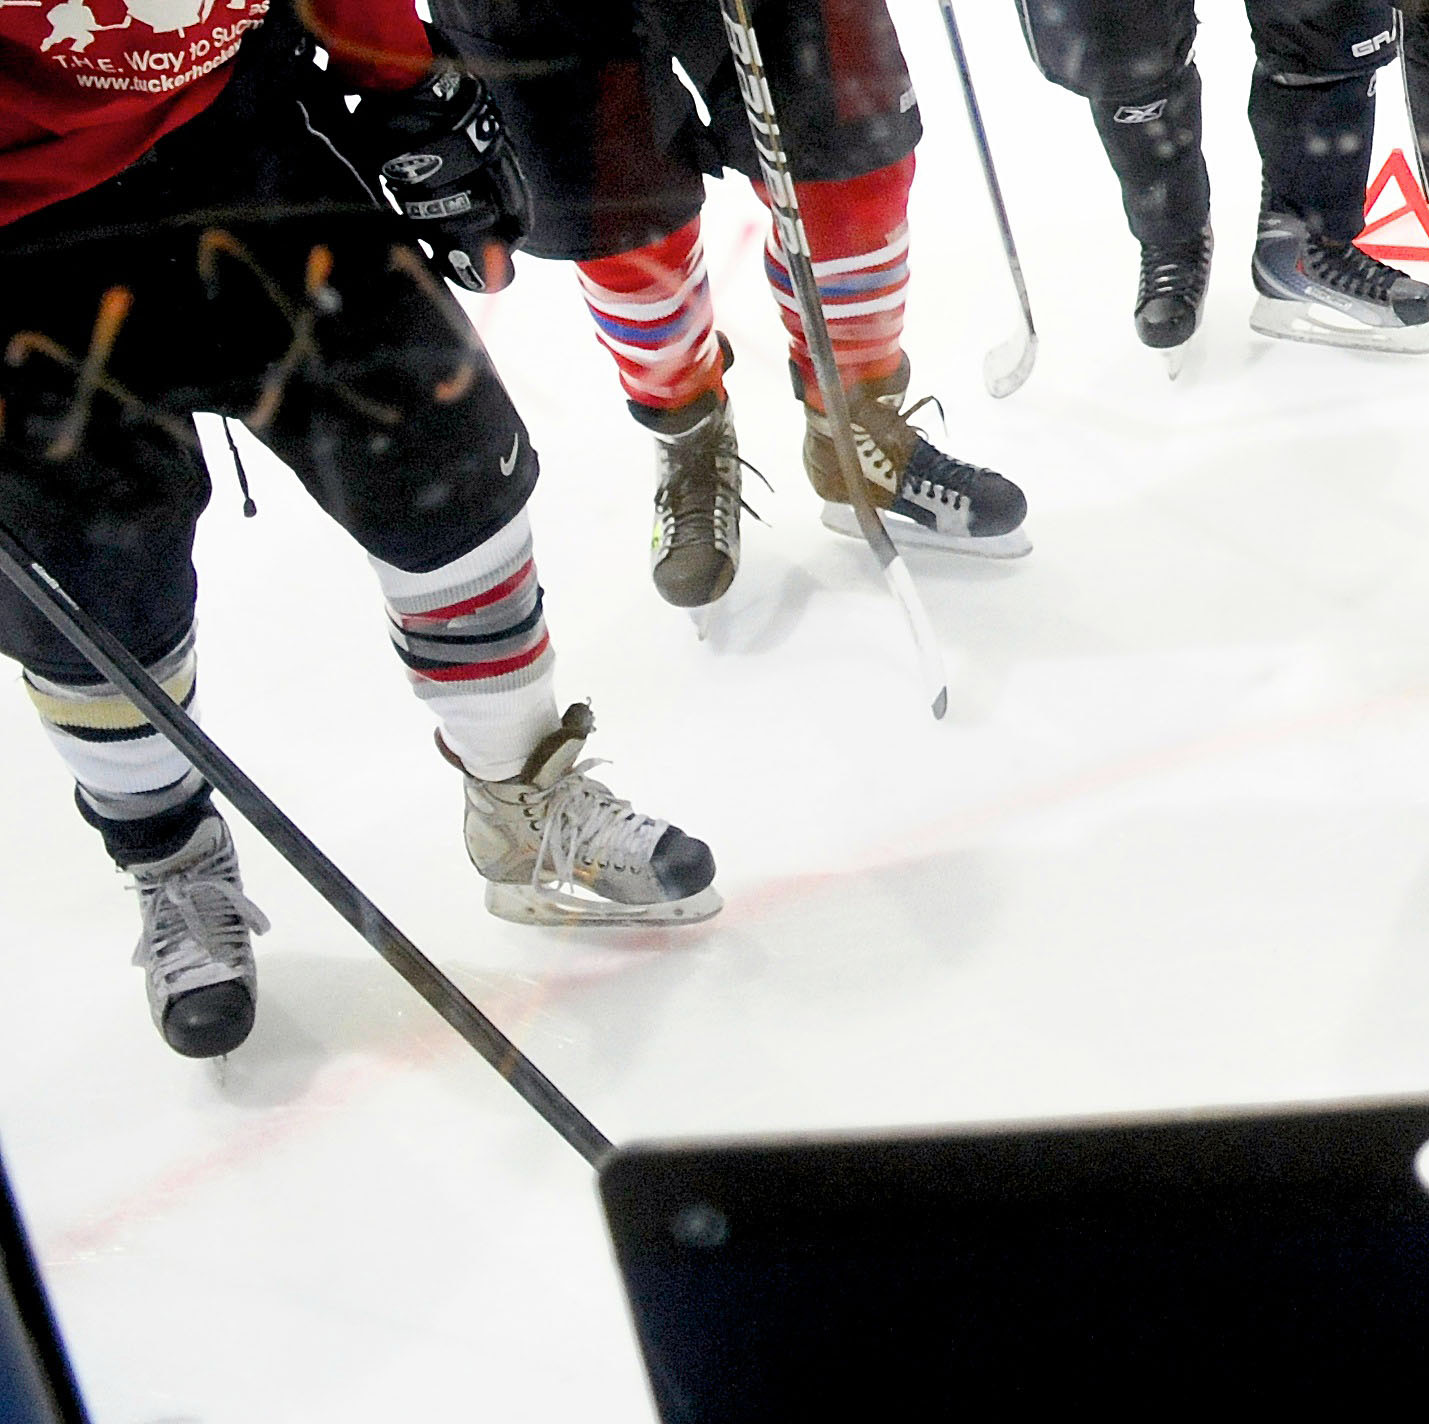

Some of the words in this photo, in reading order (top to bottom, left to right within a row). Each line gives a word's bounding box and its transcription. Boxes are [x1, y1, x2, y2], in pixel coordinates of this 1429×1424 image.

[52, 54, 124, 74] T.H.E.
[123, 50, 185, 74] Way
[189, 29, 210, 62] to
